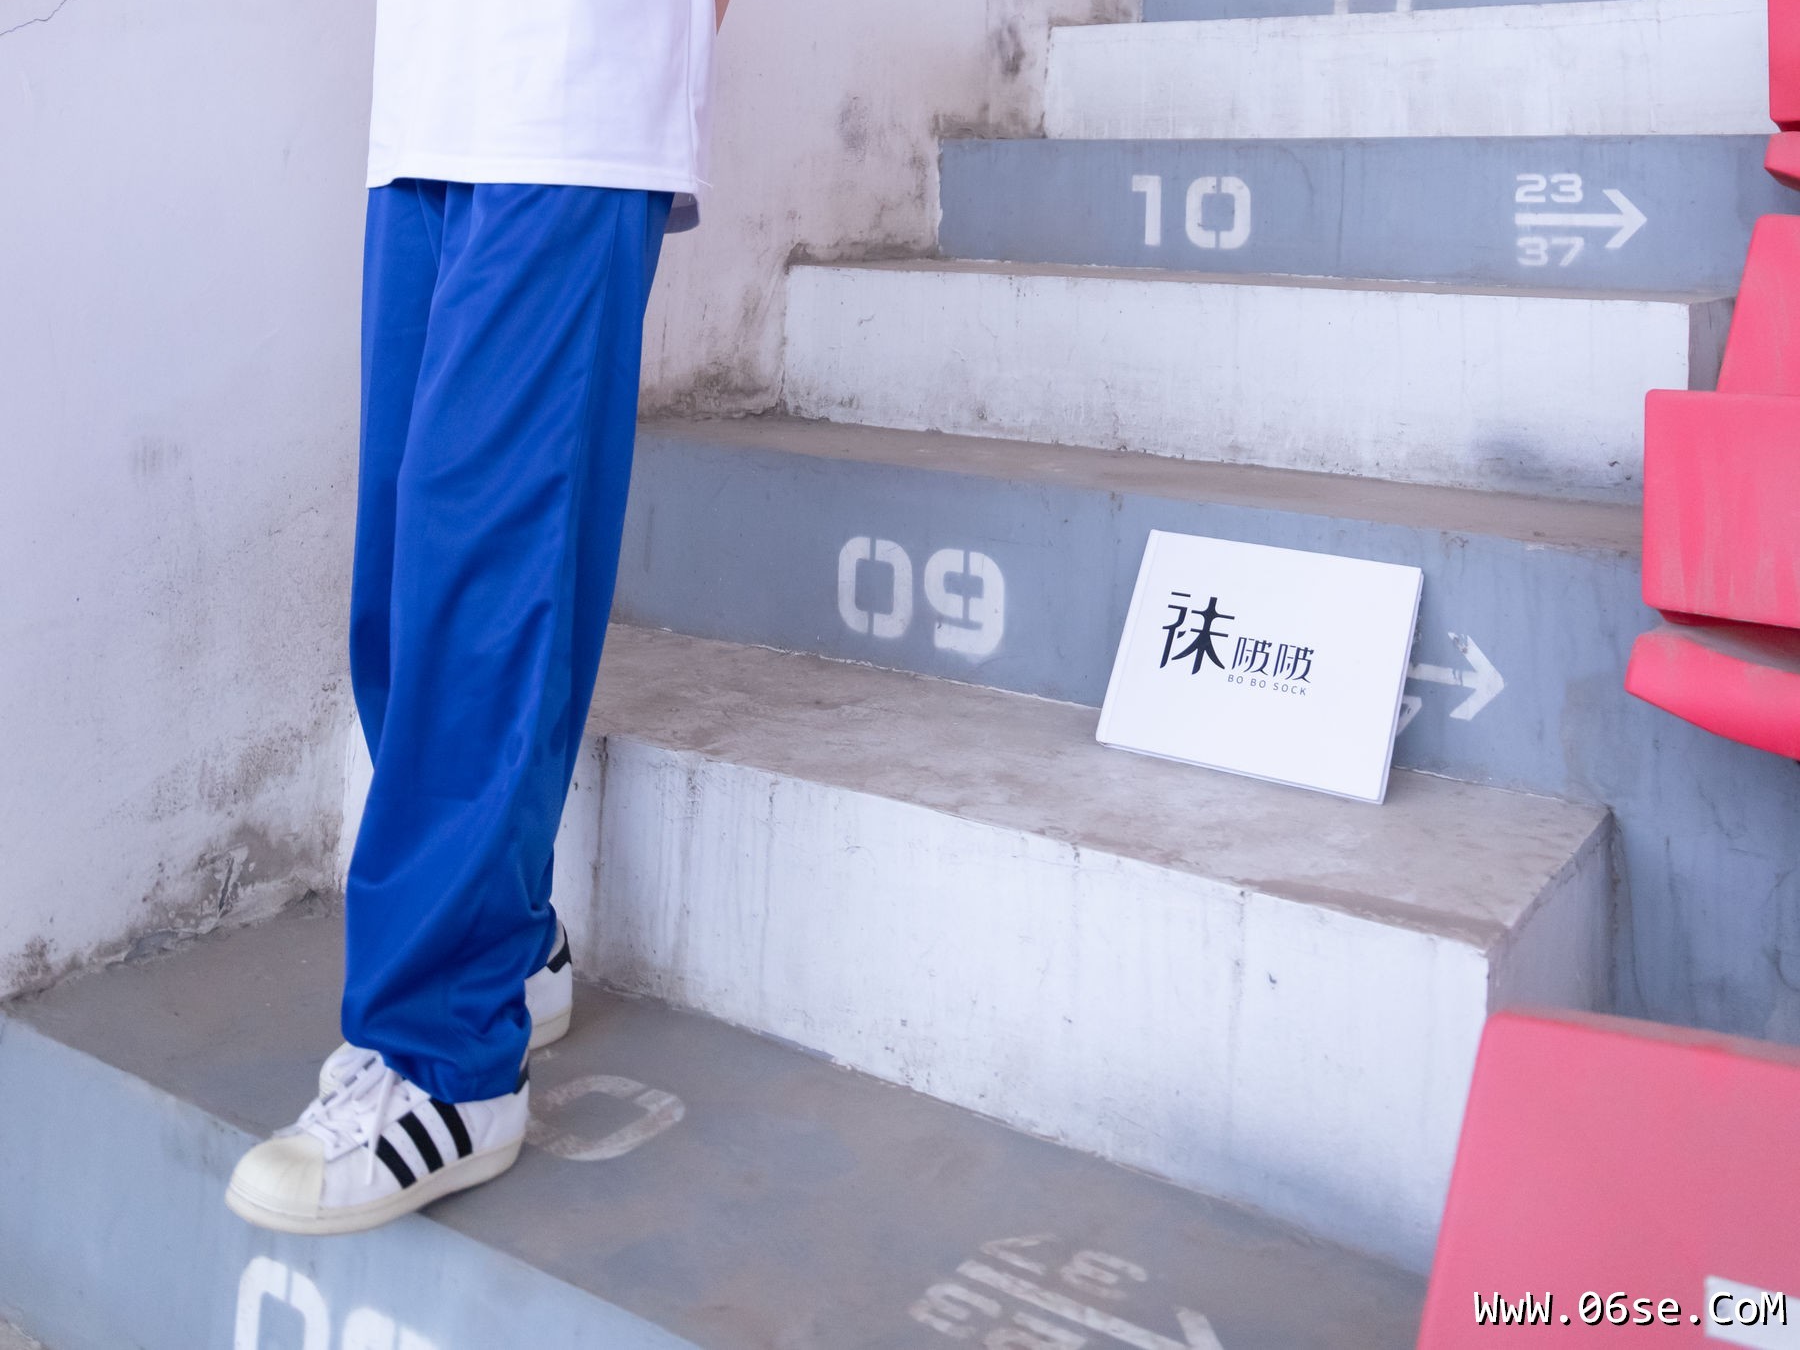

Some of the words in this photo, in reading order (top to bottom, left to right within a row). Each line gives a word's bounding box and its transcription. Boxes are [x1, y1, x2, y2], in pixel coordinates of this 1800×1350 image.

[1514, 173, 1584, 204] 23
[1131, 174, 1252, 250] 10
[1516, 236, 1585, 267] 37
[837, 536, 1006, 662] 09
[1227, 674, 1244, 684] BO
[1250, 678, 1267, 689] BO
[1273, 682, 1307, 696] SOCK
